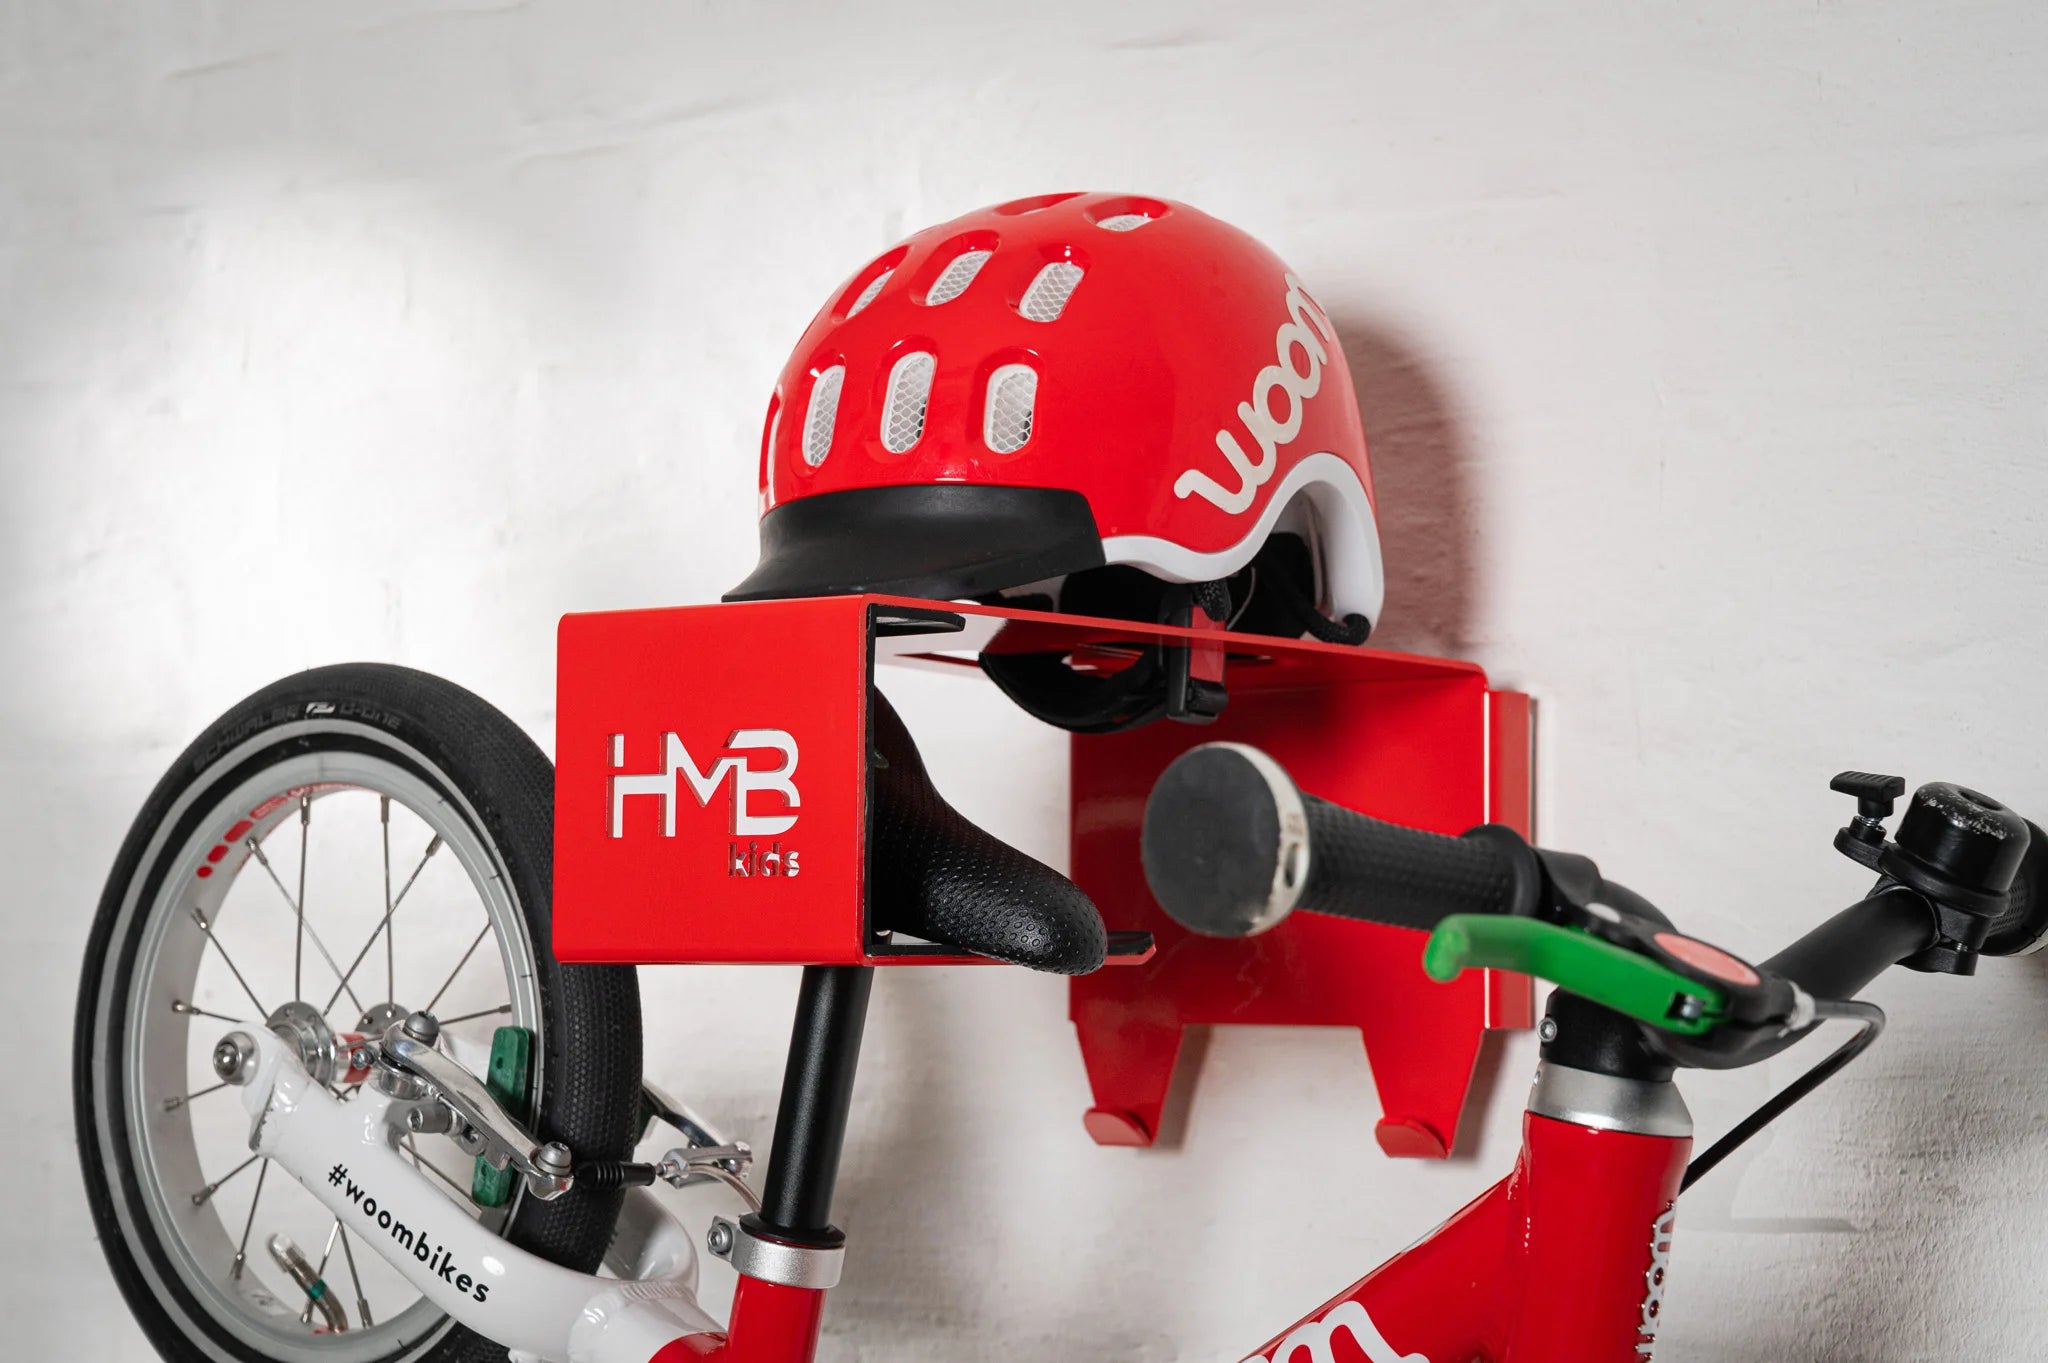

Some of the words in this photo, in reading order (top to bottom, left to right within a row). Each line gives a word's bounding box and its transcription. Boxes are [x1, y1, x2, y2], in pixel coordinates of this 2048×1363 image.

[607, 729, 801, 838] HMB
[728, 841, 800, 877] kids
[328, 1163, 490, 1303] #woombikes
